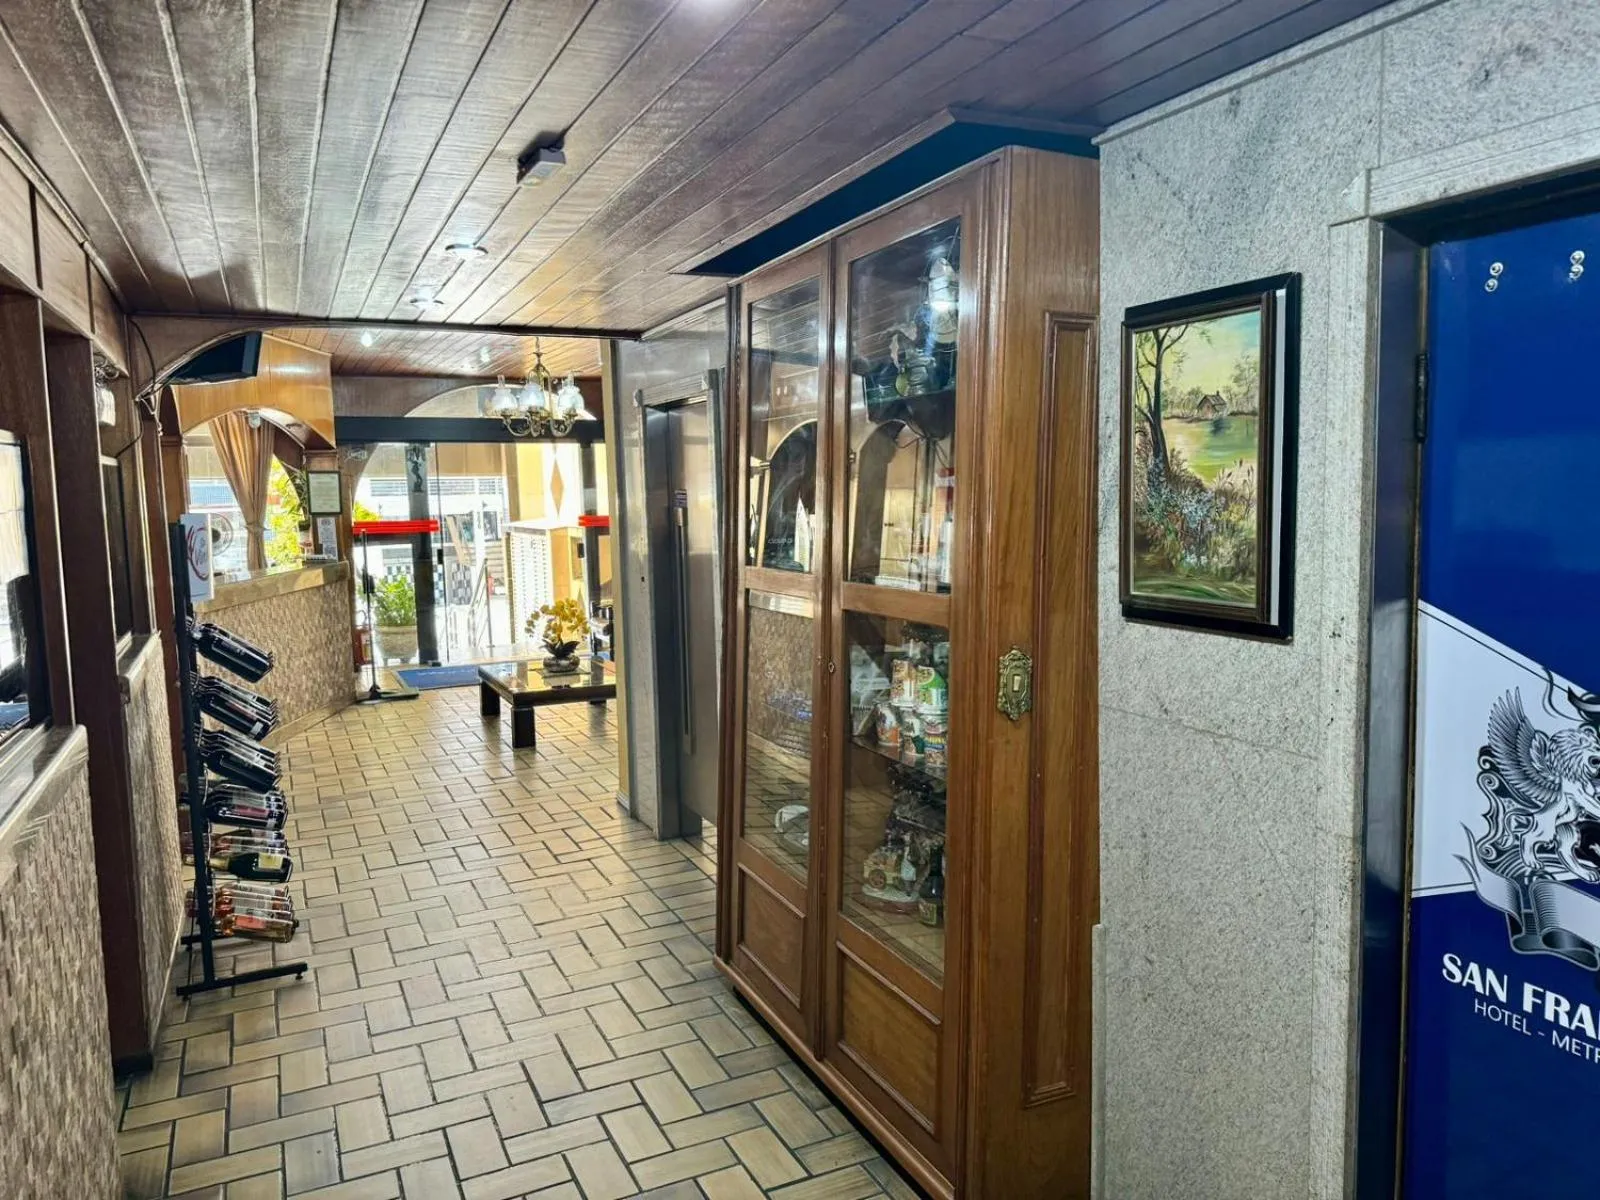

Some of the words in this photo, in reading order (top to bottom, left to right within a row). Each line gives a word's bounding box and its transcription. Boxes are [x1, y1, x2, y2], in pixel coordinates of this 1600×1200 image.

[1442, 953, 1508, 1003] SAN
[1522, 982, 1600, 1040] FRA
[1474, 998, 1532, 1036] HOTEL
